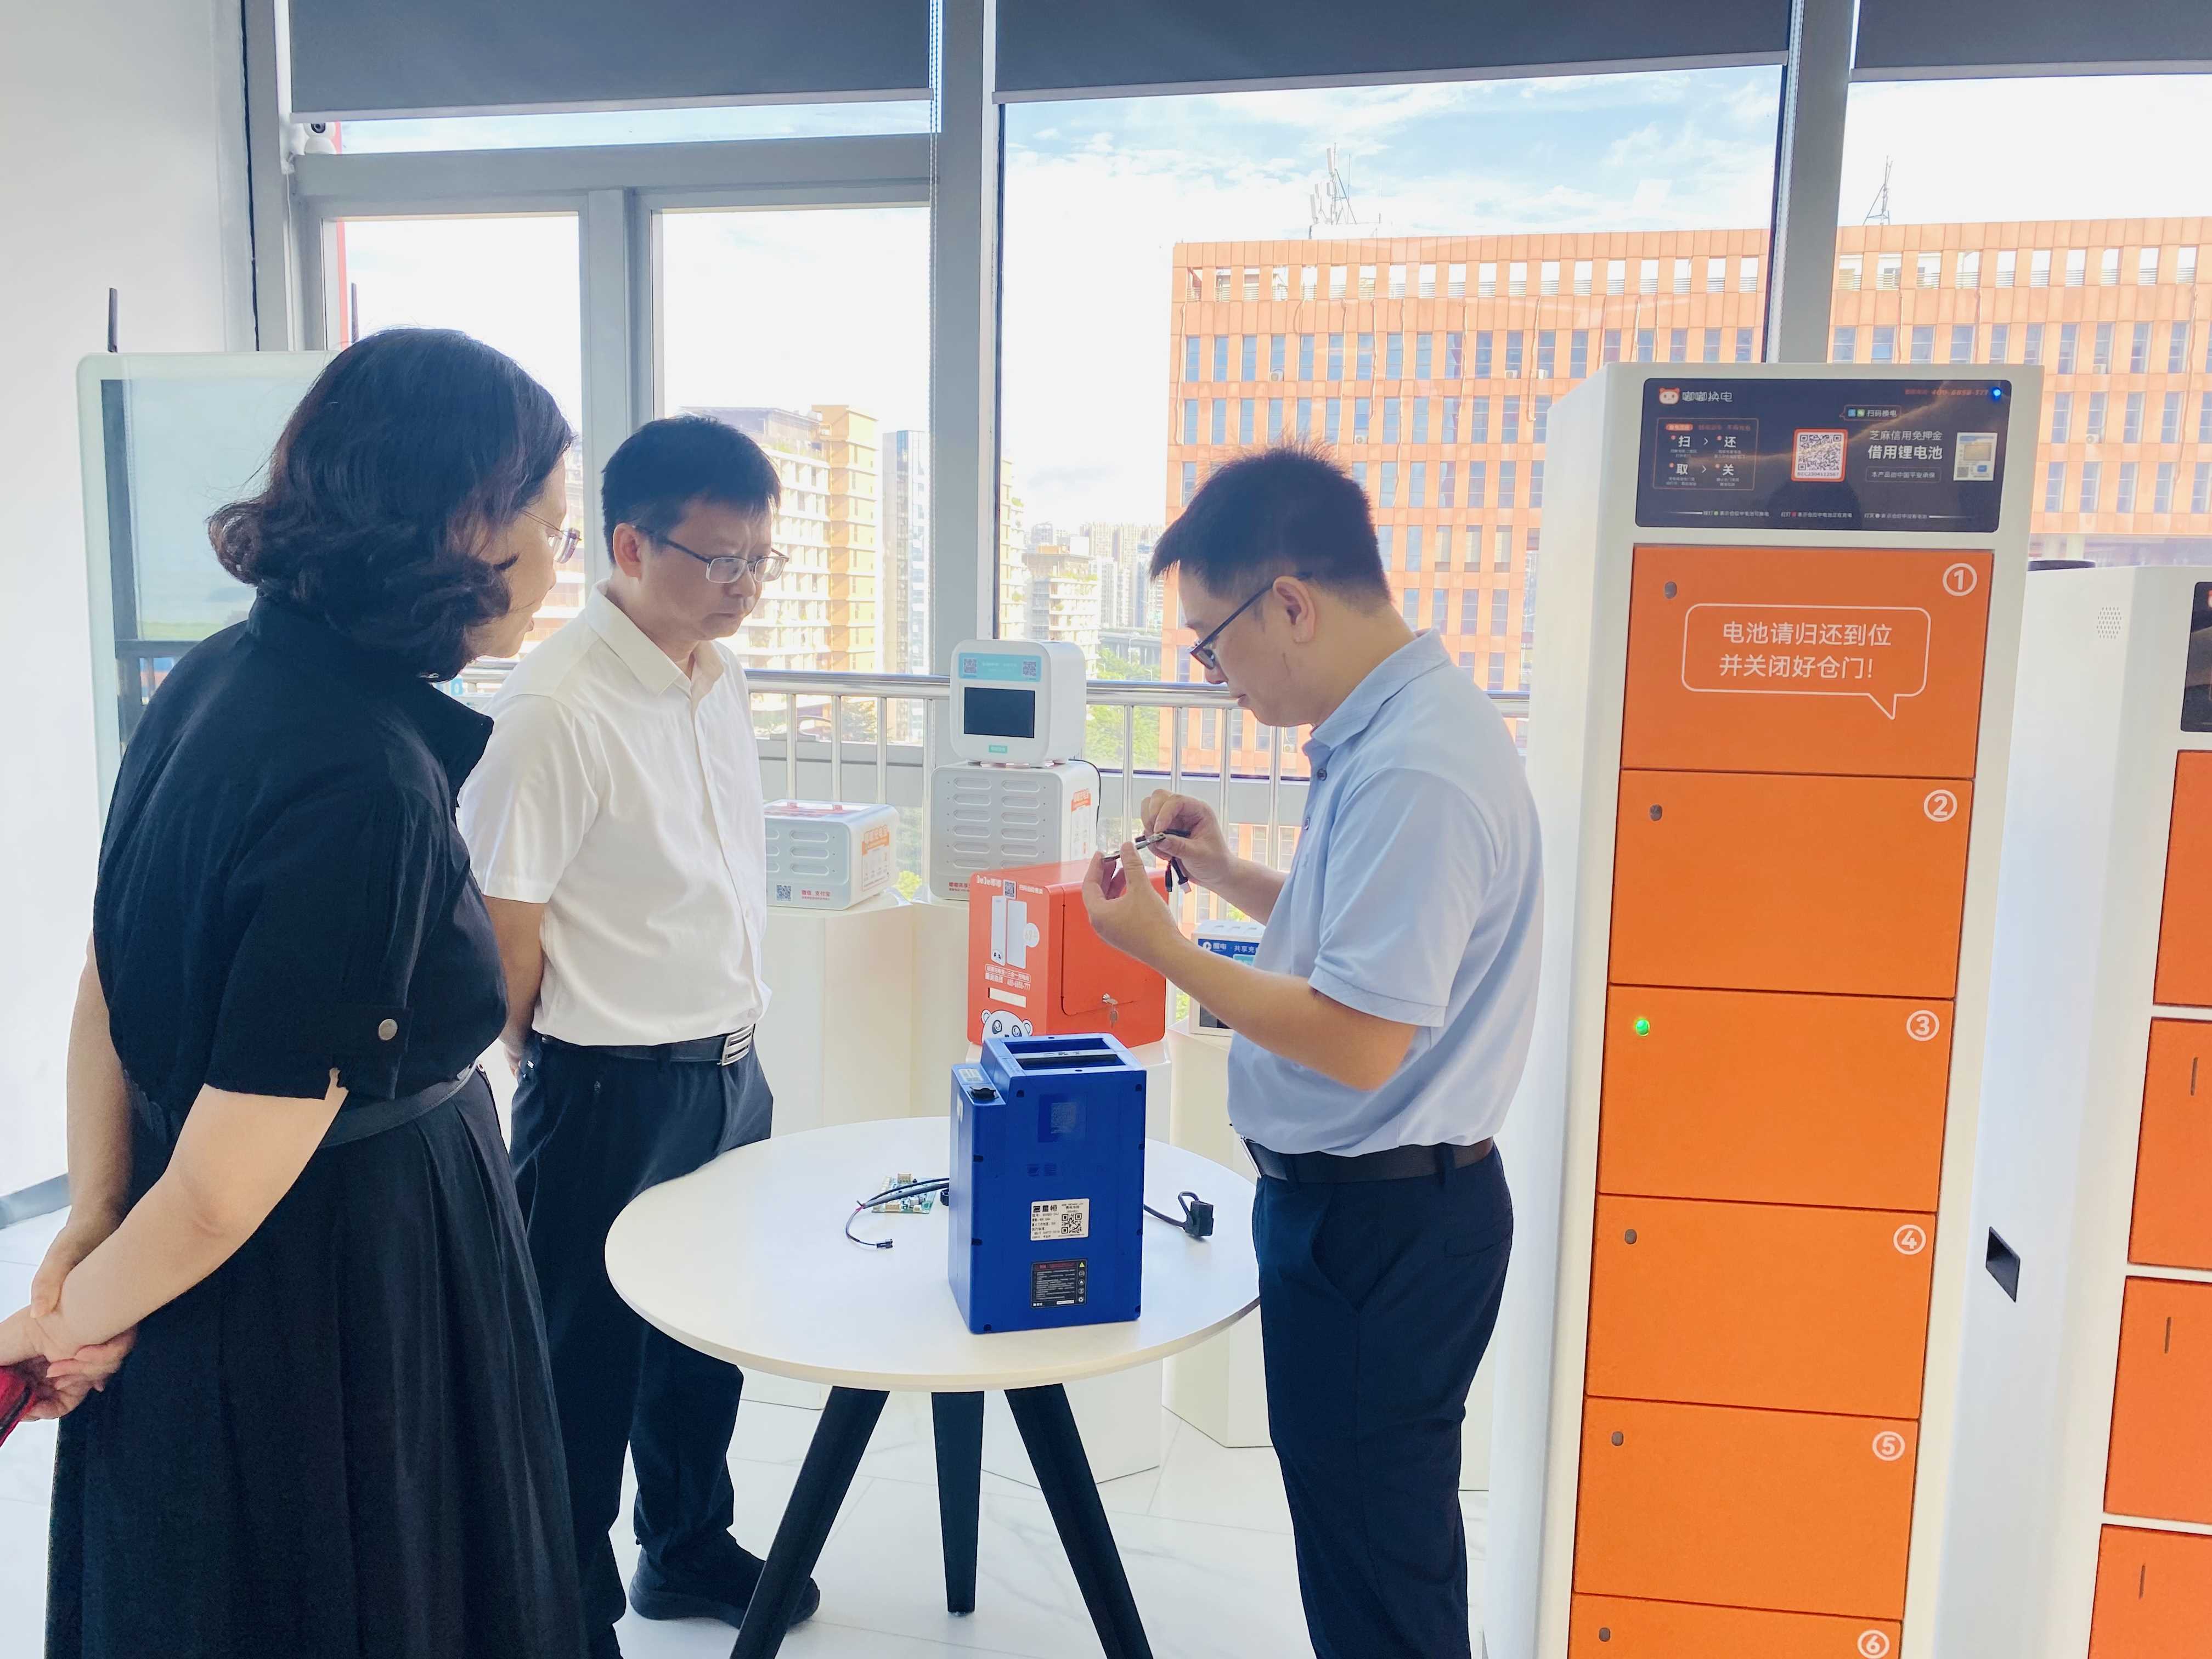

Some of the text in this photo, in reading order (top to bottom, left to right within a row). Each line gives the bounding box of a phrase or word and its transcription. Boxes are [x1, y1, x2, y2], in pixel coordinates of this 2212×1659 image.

[1682, 390, 1733, 402] 嘟嘟换电
[1866, 409, 1898, 417] 扫码换电
[1678, 435, 1691, 448] 扫
[1869, 430, 1943, 441] 芝麻信用免押金
[1724, 436, 1736, 448] 还
[1867, 444, 1943, 460] 借用锂电池
[1676, 463, 1689, 475] 取
[1722, 464, 1734, 476] 关
[1871, 471, 1936, 479] 本产品由中国平安承保
[1722, 621, 1892, 647] 电池请归还到位
[1718, 653, 1874, 679] 并关闭好仓门!
